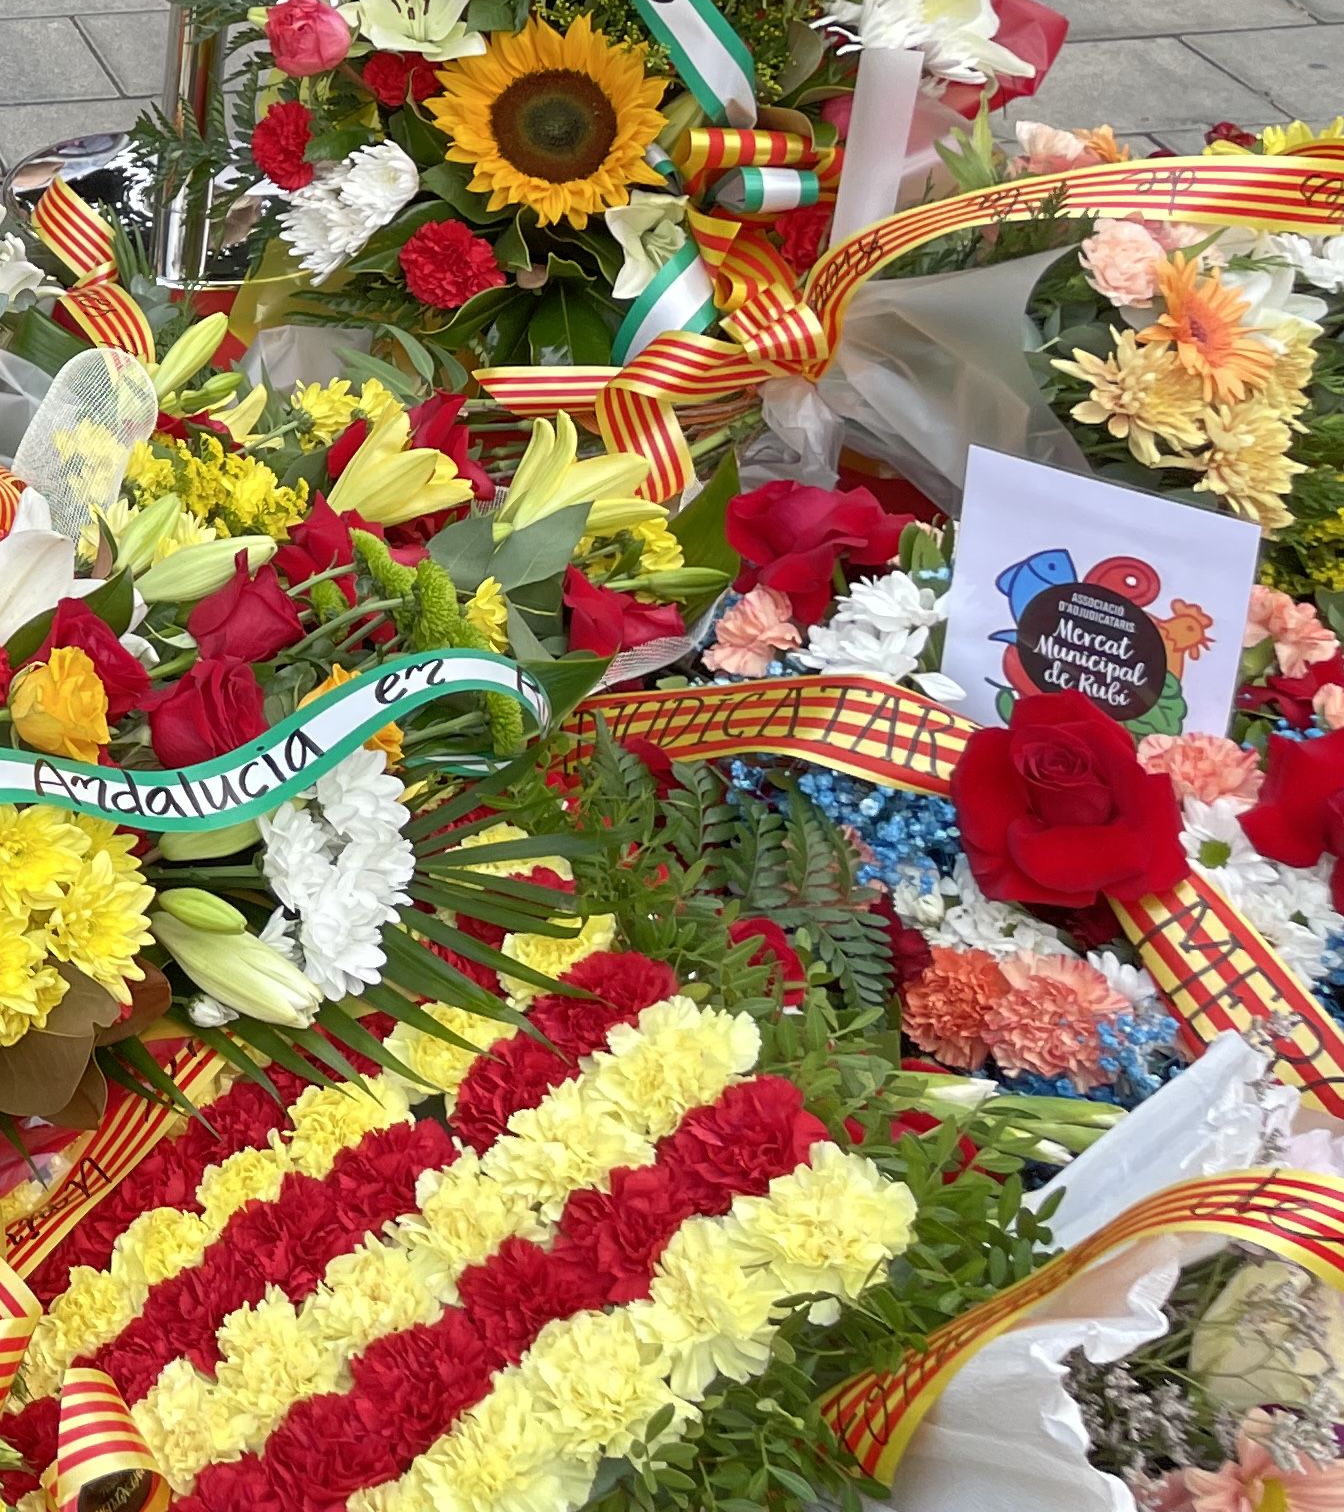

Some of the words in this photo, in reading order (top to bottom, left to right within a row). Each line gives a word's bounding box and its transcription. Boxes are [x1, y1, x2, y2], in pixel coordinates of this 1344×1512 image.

[1071, 592, 1125, 617] ASSOCIACIÓ
[1033, 634, 1148, 686] Municipal
[1052, 617, 1135, 660] Mercat
[375, 658, 446, 705] en
[1044, 660, 1074, 690] de
[1078, 672, 1131, 706] Rubí
